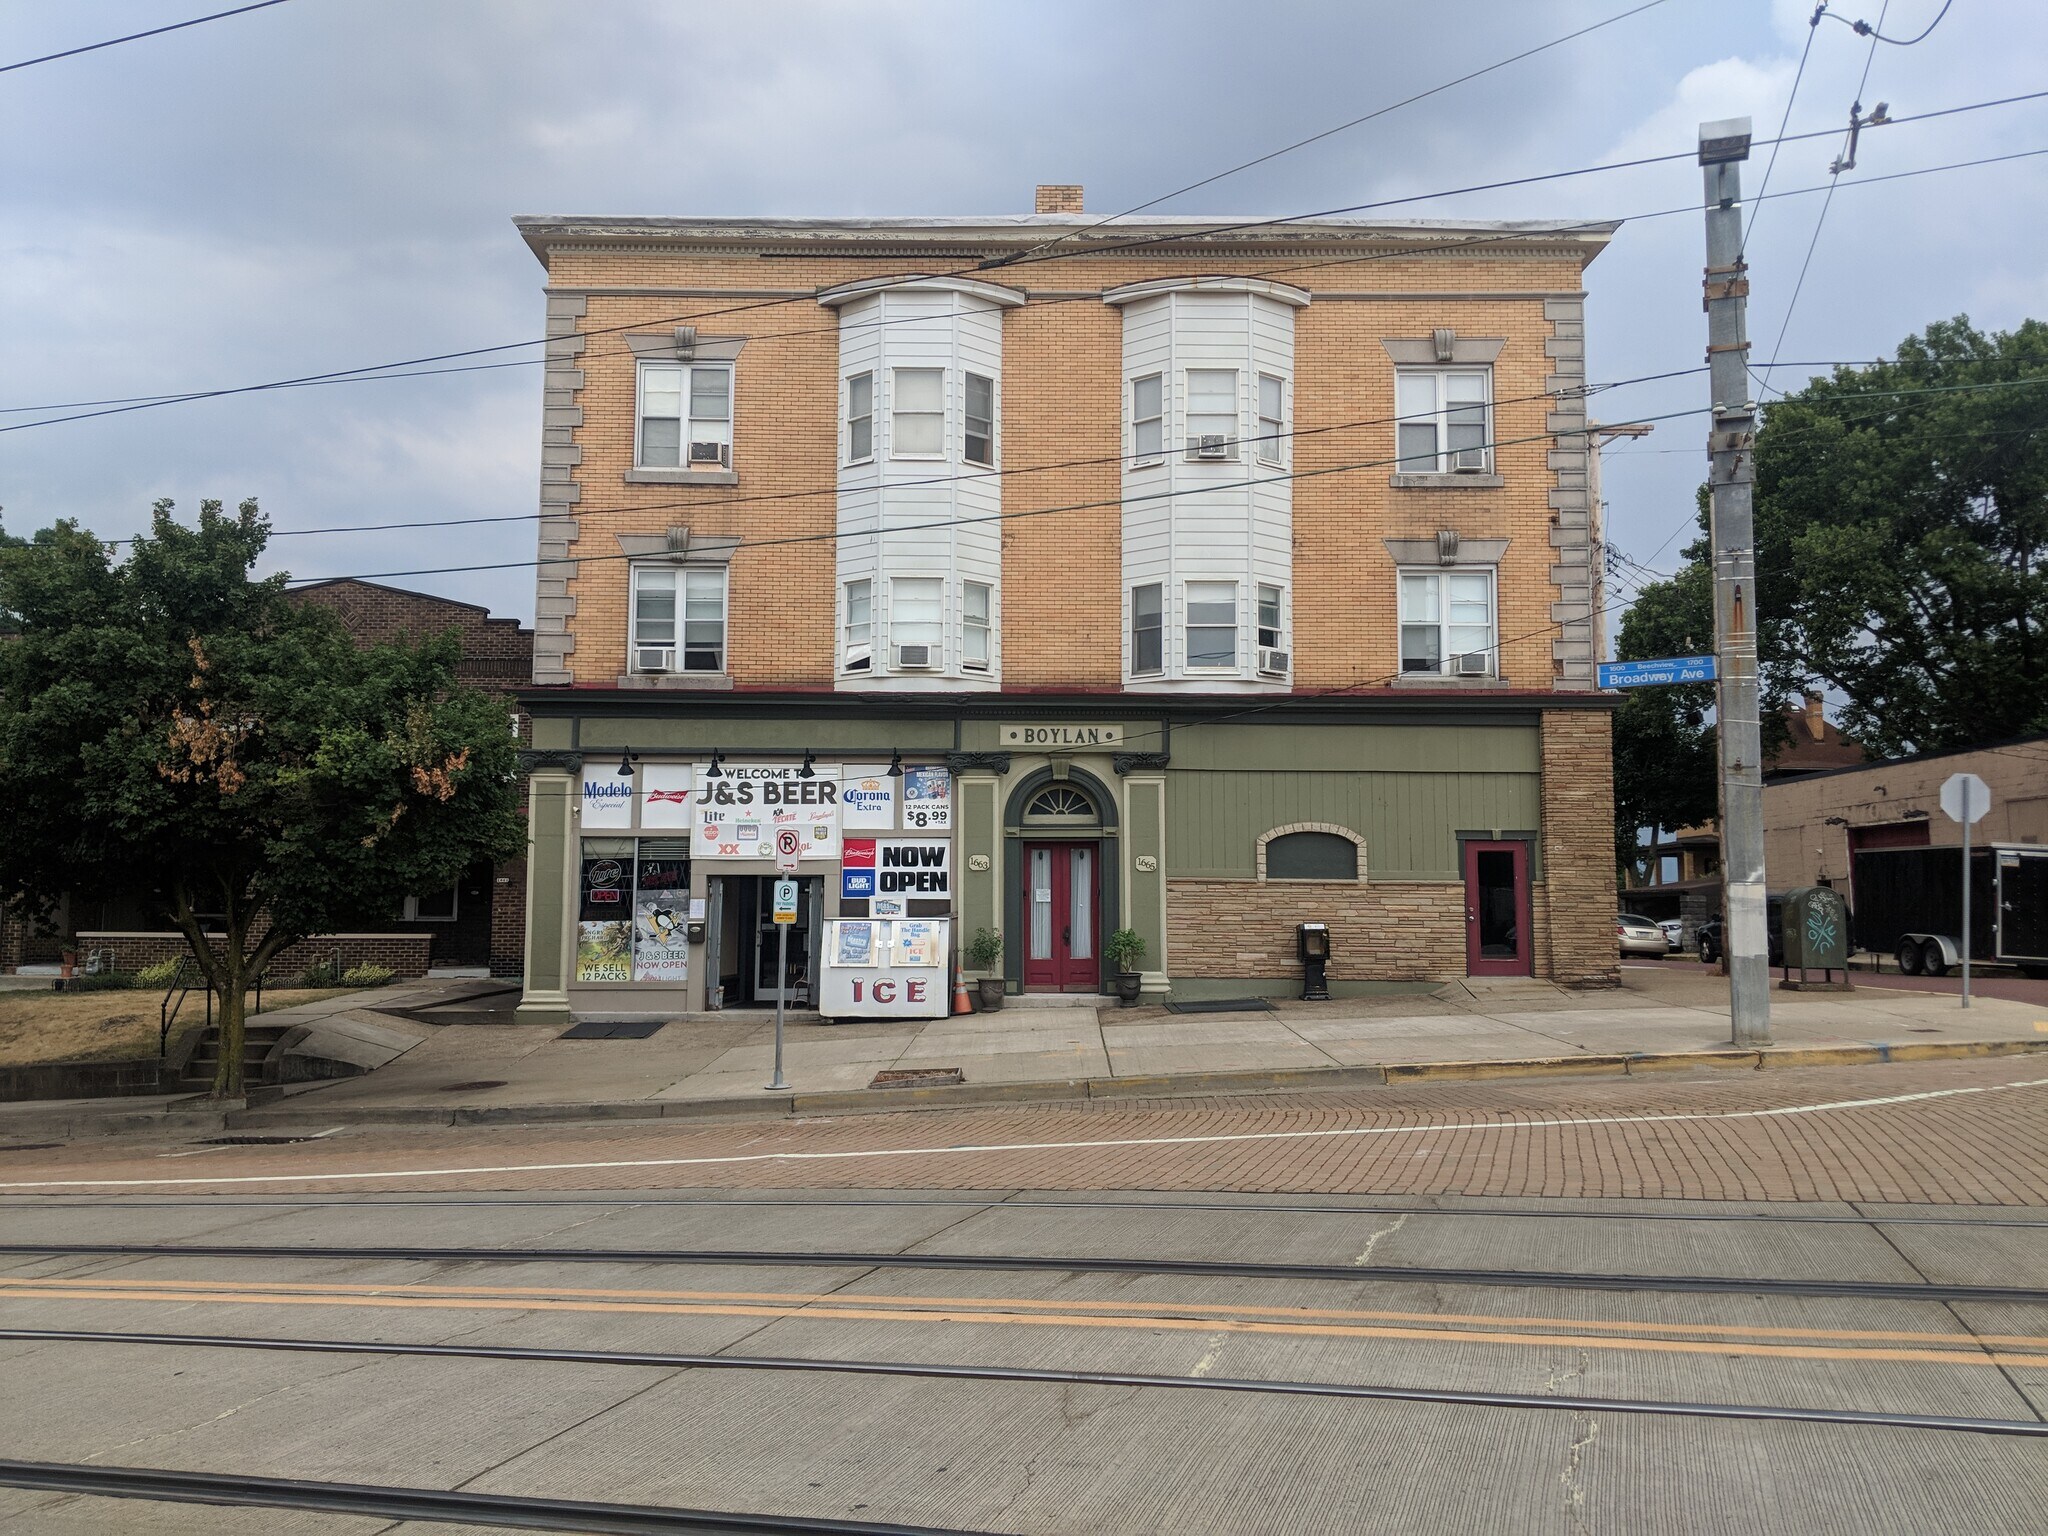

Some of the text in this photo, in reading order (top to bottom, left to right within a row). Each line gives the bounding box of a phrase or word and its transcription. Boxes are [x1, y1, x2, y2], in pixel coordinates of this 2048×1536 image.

[1637, 661, 1674, 670] Beechview
[1609, 668, 1704, 685] Broadway Ave
[1024, 728, 1099, 744] BOYLAN
[724, 768, 790, 779] WELCOME
[584, 782, 632, 799] Modelo
[696, 781, 837, 806] J&S BEER
[843, 788, 890, 803] Corona
[590, 799, 625, 811] Especial
[856, 802, 882, 811] Extra
[704, 810, 725, 824] Lite
[772, 813, 797, 824] TECATE
[907, 811, 948, 828] $8.99
[718, 844, 740, 854] XX
[883, 846, 946, 867] NOW
[970, 858, 988, 870] 1663
[1137, 858, 1156, 870] 1665
[880, 872, 948, 892] OPEN
[592, 891, 618, 900] OPEN
[662, 950, 686, 960] BEER
[584, 964, 626, 972] WE SELL
[636, 961, 688, 970] NOW OPEN
[582, 972, 627, 980] 12 PACKS
[852, 976, 928, 1004] ICE
